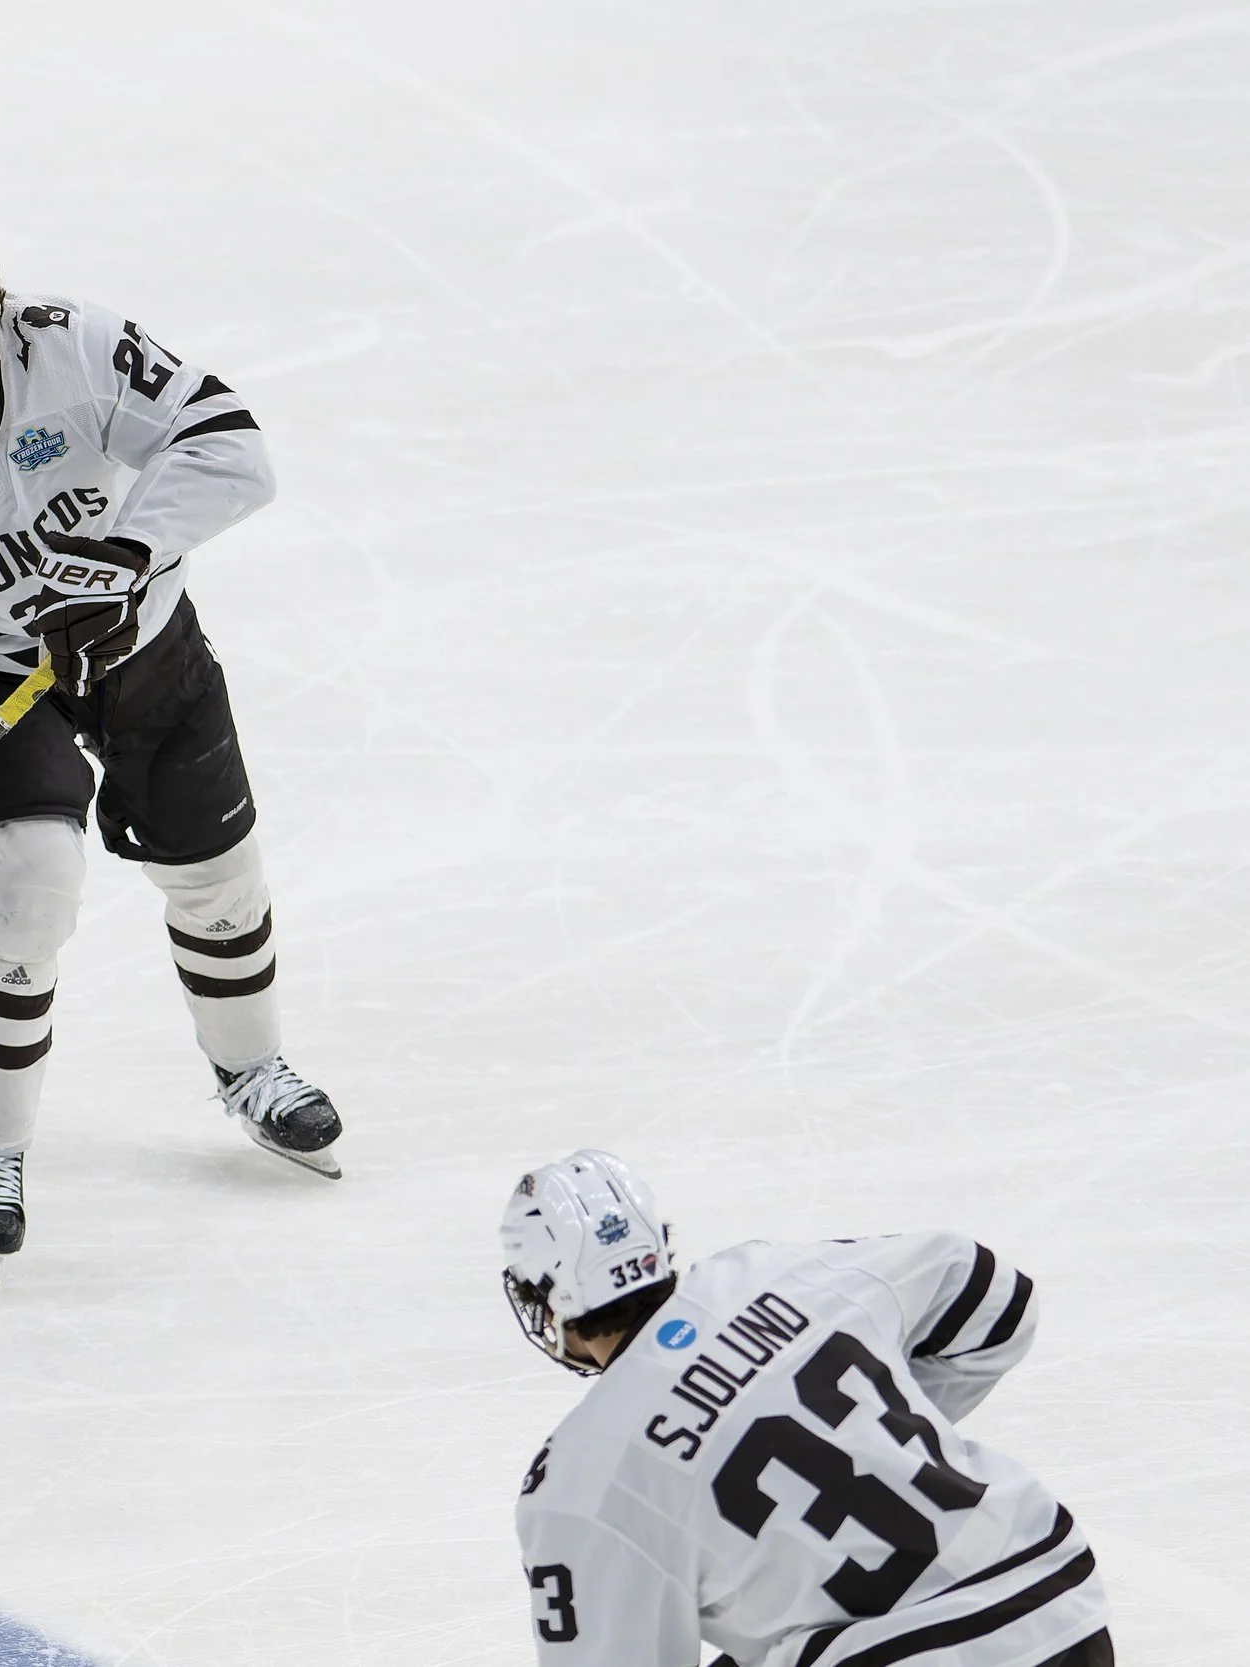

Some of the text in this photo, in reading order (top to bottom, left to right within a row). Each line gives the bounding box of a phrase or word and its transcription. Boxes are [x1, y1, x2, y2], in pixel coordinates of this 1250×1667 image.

[16, 441, 44, 461] FROZEN
[43, 436, 62, 450] FOUR
[36, 557, 119, 591] UER
[1, 977, 32, 985] adidas
[608, 1258, 643, 1289] 33
[644, 1292, 810, 1462] SJOLUND
[712, 1331, 989, 1618] 33
[524, 1563, 579, 1642] 3
